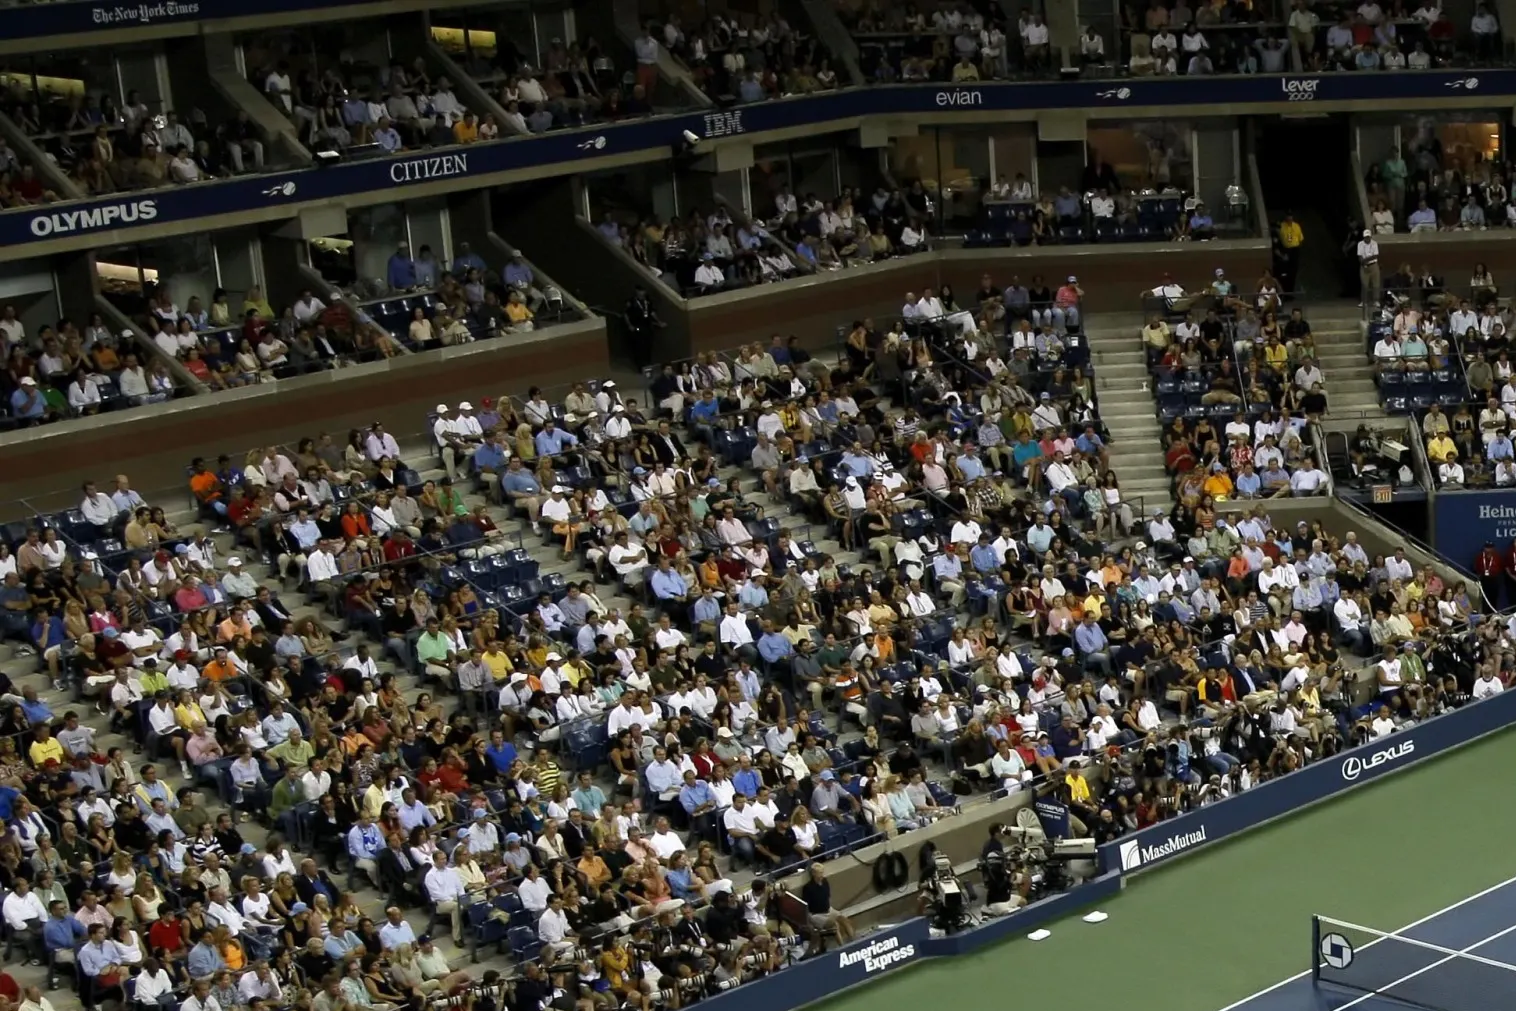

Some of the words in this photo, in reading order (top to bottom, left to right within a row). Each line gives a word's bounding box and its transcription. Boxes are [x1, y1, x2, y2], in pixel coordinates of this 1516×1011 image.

[92, 8, 114, 23] The
[115, 6, 138, 22] New
[139, 3, 166, 22] York
[166, 1, 200, 16] Times
[936, 87, 982, 106] evian
[1281, 77, 1320, 92] Lever
[1288, 92, 1314, 100] 2000
[703, 110, 742, 137] IBM
[390, 153, 467, 183] CITIZEN
[30, 200, 158, 236] OLYMPUS
[1362, 740, 1415, 769] LEXUS
[1142, 825, 1207, 864] MassMutual
[840, 936, 899, 968] American
[864, 944, 915, 972] Express
